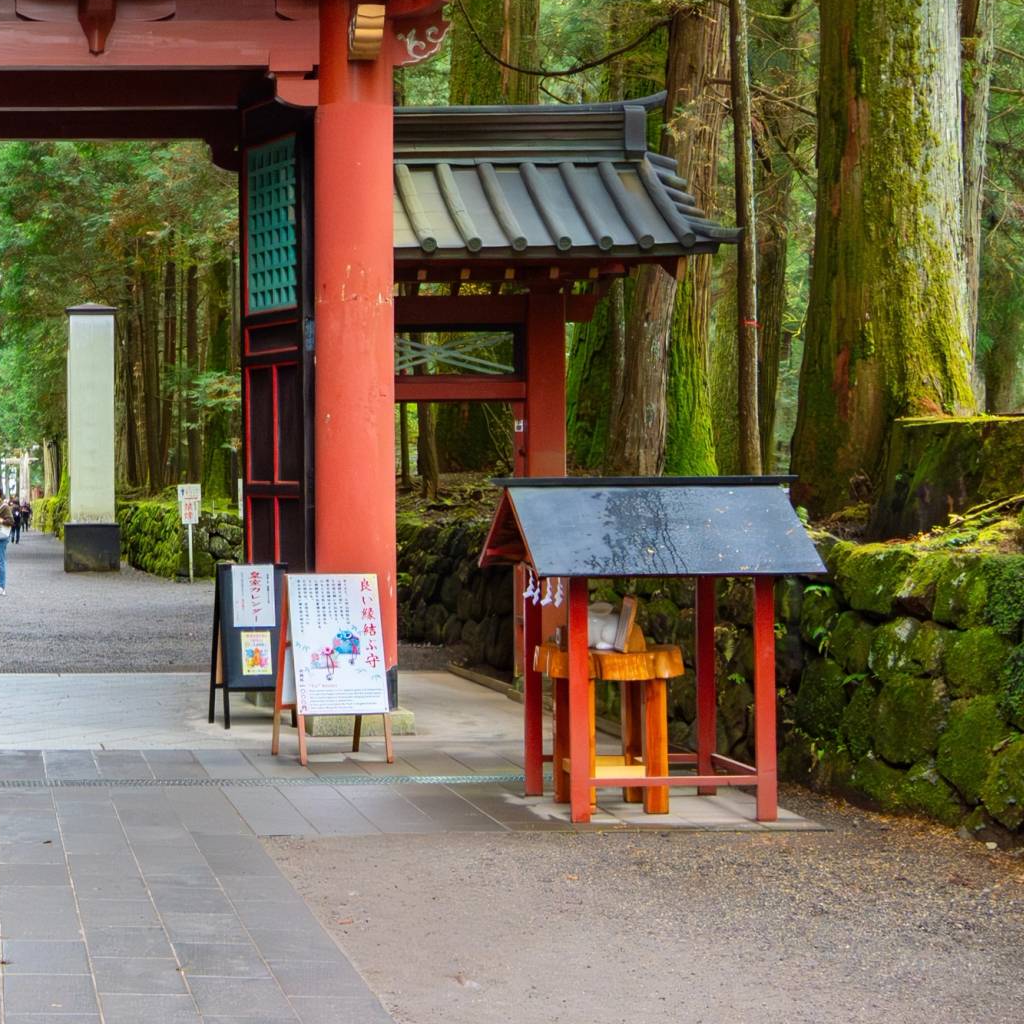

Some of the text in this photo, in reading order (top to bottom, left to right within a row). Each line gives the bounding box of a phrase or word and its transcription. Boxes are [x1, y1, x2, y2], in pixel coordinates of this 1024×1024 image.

[360, 578, 381, 668] 良い縁結ぶ守
